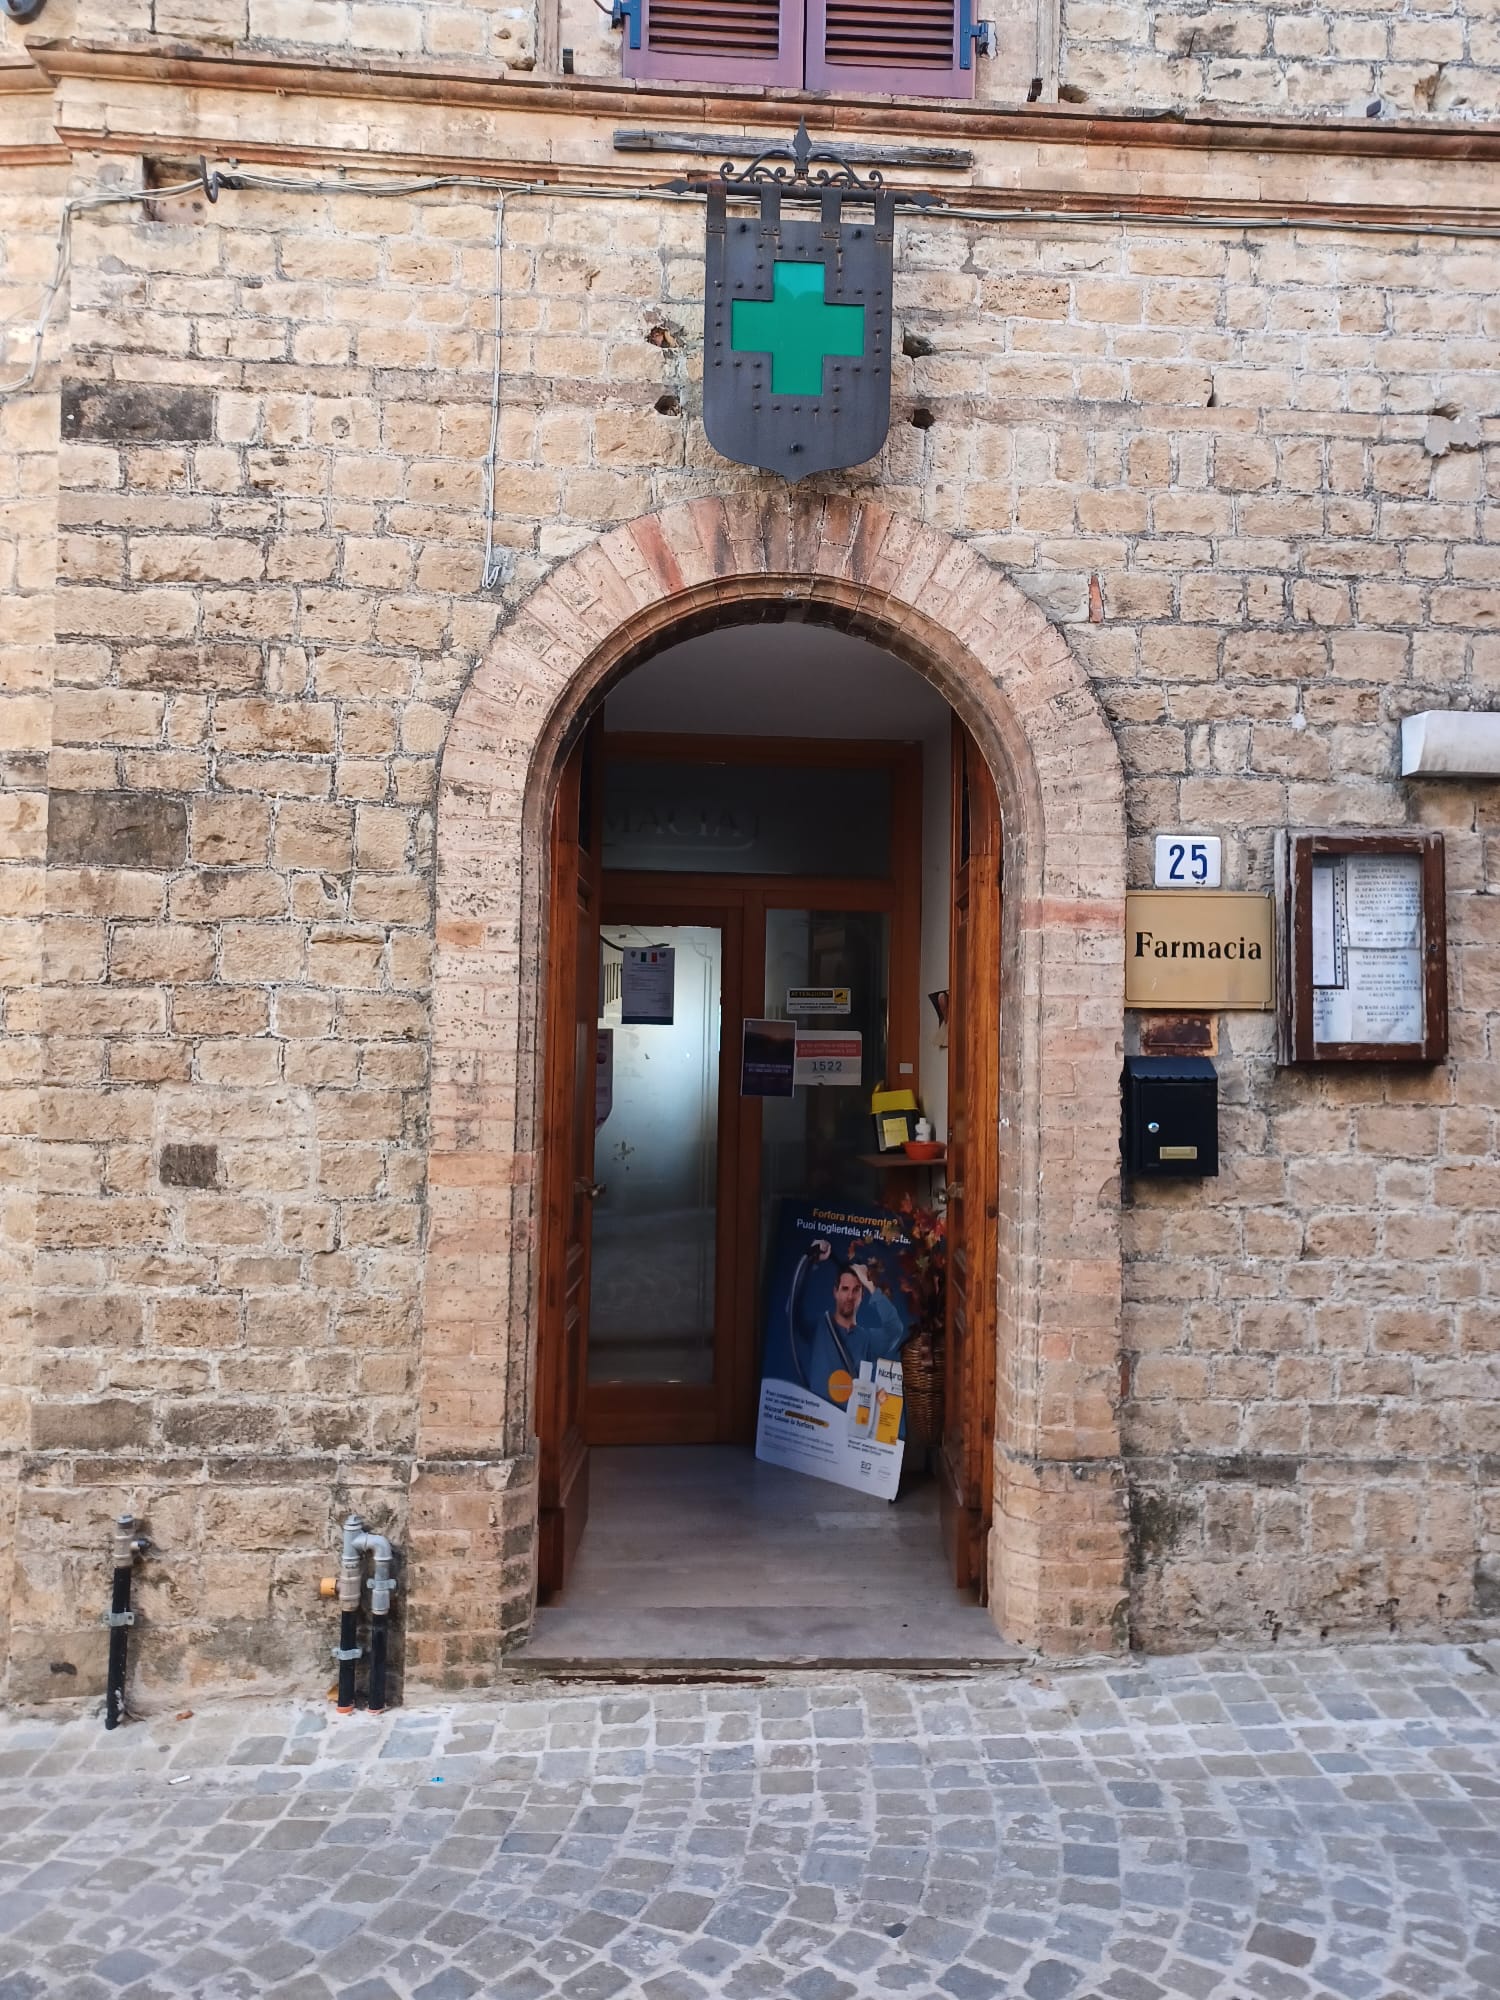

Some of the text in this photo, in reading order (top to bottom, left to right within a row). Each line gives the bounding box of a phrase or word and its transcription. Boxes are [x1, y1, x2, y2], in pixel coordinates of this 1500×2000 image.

[1168, 844, 1208, 880] 25
[1135, 931, 1262, 959] Farmacia
[812, 1060, 842, 1073] 1522
[813, 1207, 846, 1223] Forfora
[797, 1217, 816, 1231] Puoi
[817, 1222, 861, 1238] togliertela
